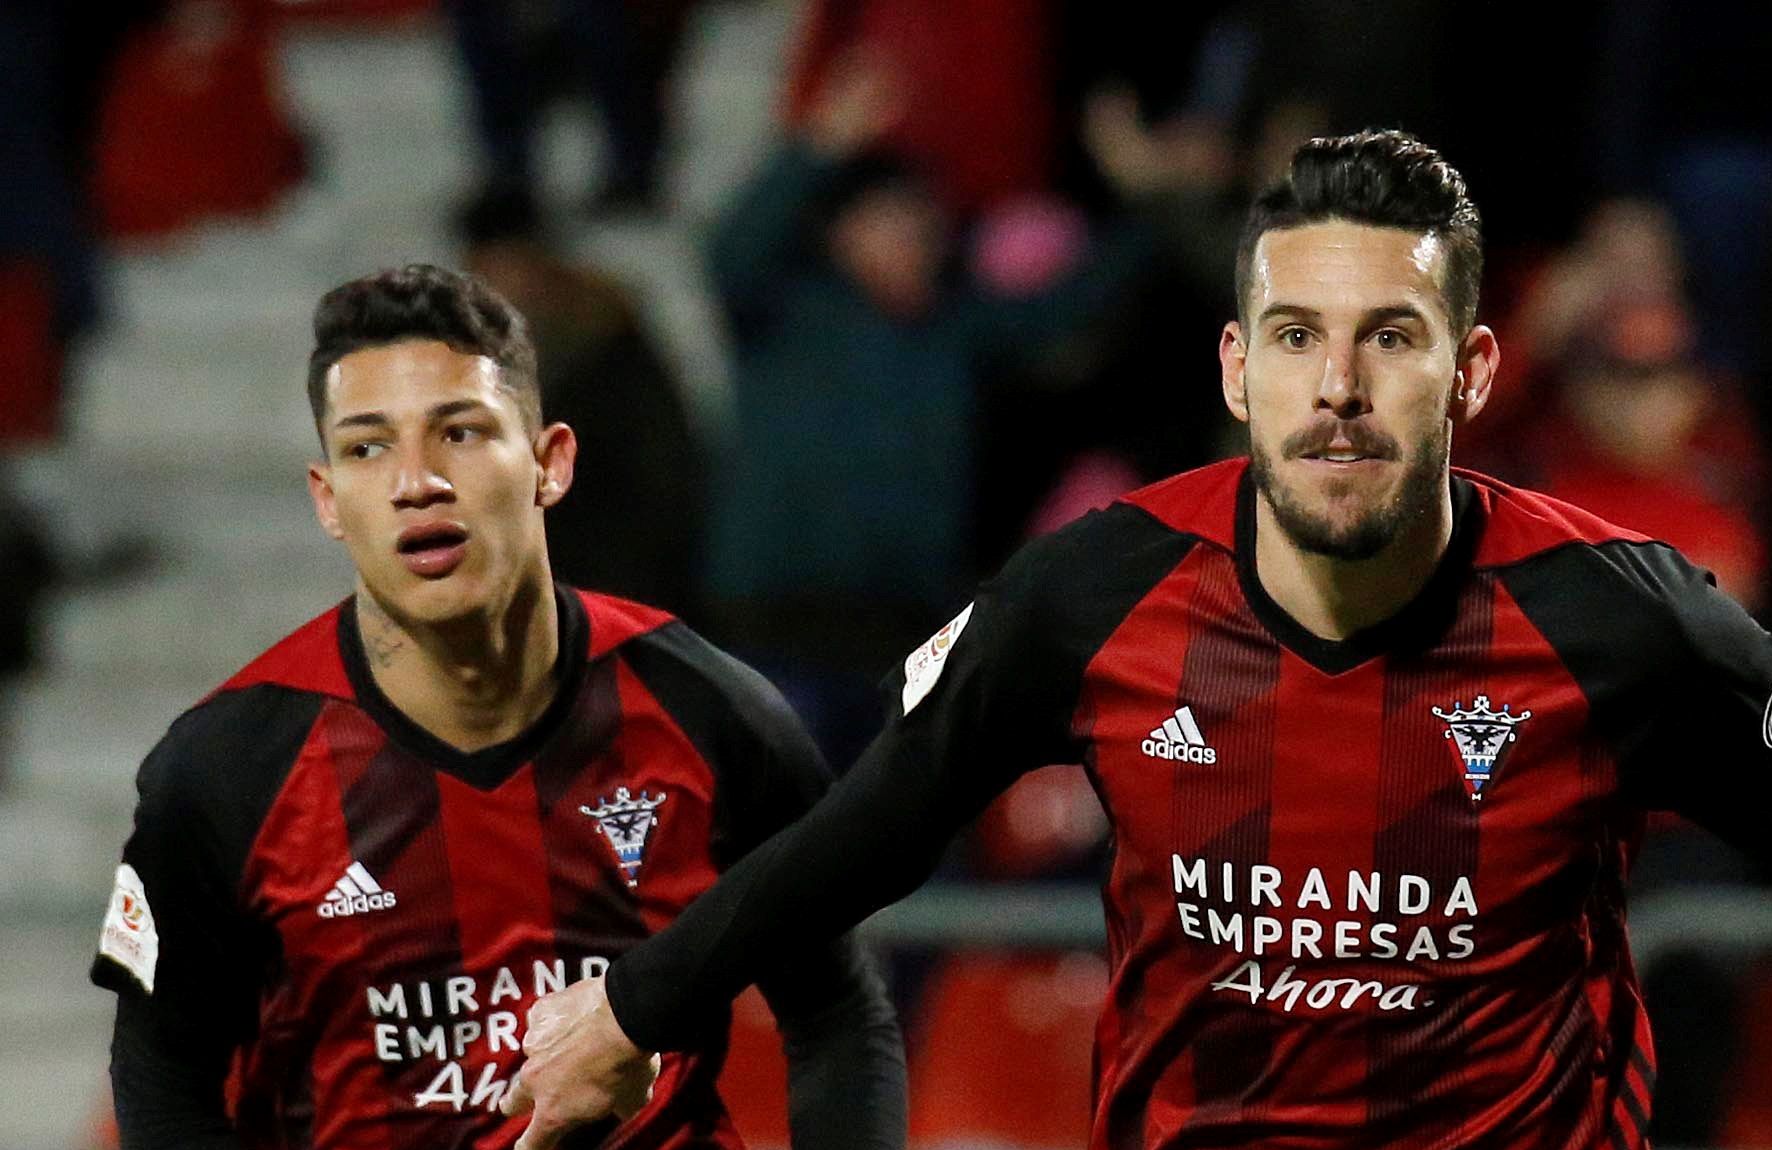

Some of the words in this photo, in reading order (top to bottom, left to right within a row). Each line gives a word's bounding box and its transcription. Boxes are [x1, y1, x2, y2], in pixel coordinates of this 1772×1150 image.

[1141, 739, 1217, 765] adidas
[316, 891, 397, 918] adidas
[1172, 853, 1479, 917] MIRANDA
[1177, 902, 1476, 962] EMPRESAS
[366, 955, 611, 1019] MIRAND
[374, 1011, 528, 1062] EMPR
